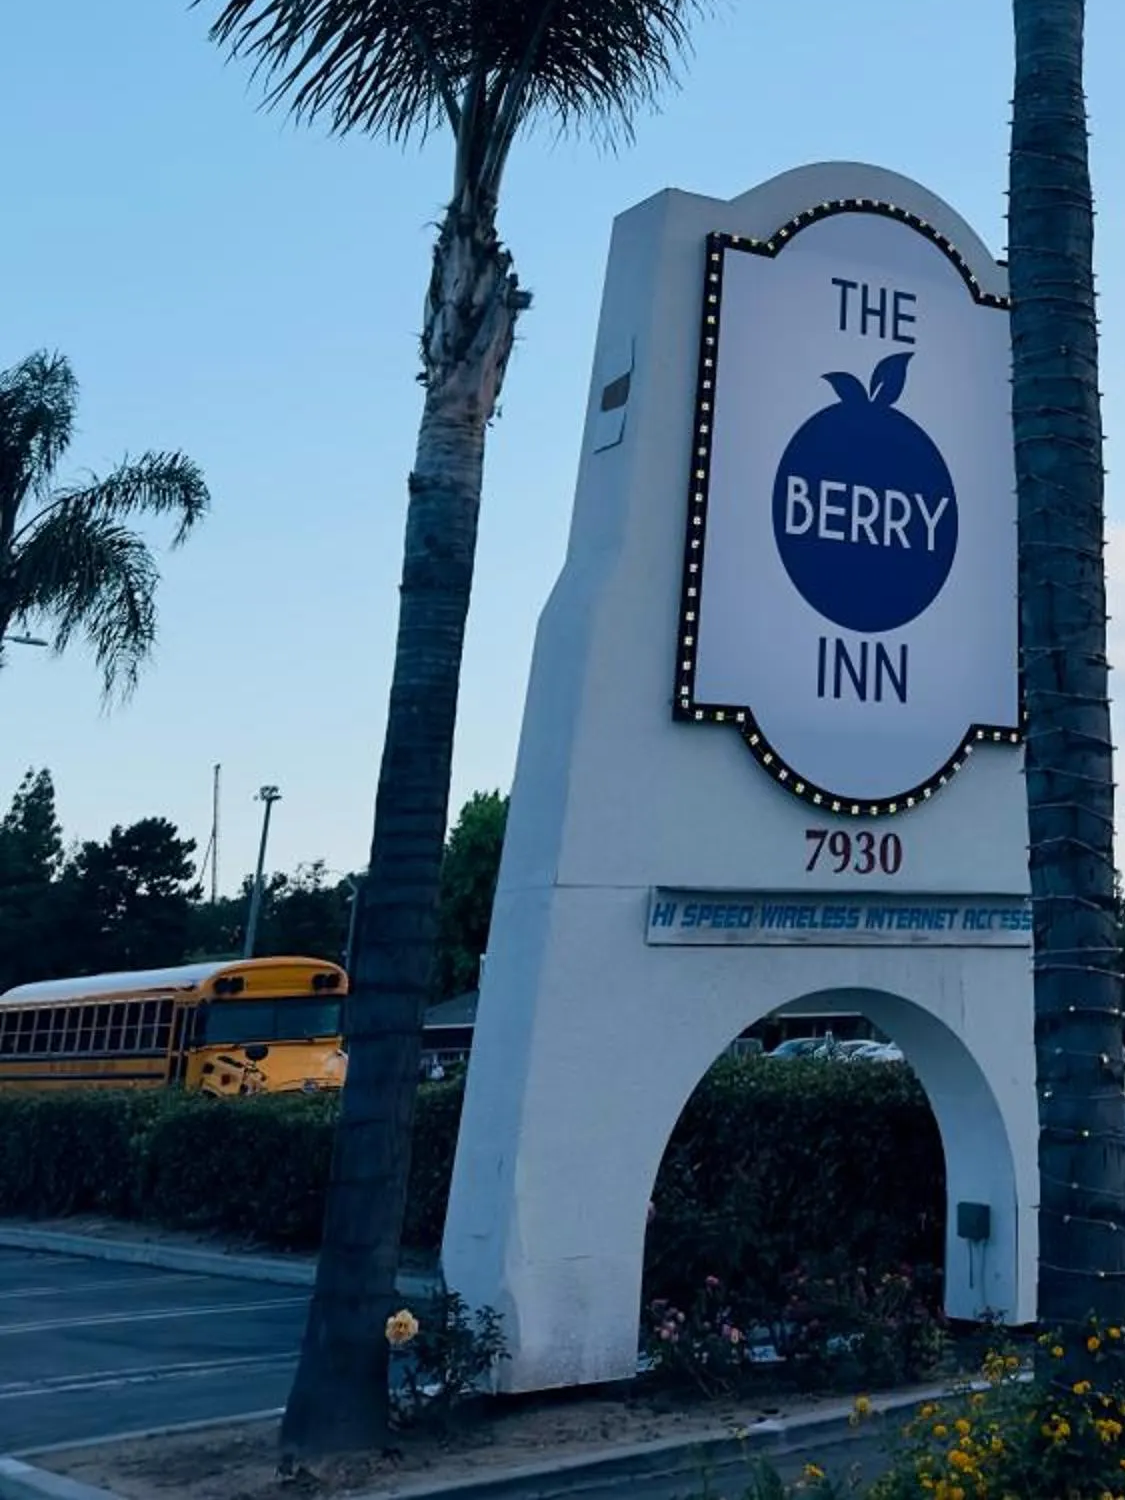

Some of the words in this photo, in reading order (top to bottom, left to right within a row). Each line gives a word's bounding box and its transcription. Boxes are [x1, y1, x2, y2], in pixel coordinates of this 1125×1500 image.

[832, 277, 916, 344] THE
[785, 476, 949, 551] BERRY
[817, 637, 909, 703] INN
[805, 829, 901, 874] 7930
[652, 903, 675, 927] HI
[681, 904, 752, 929] SPEED
[760, 905, 860, 930] WIRELESS
[865, 907, 959, 931] INTERNET
[962, 908, 1032, 931] ACCESS
